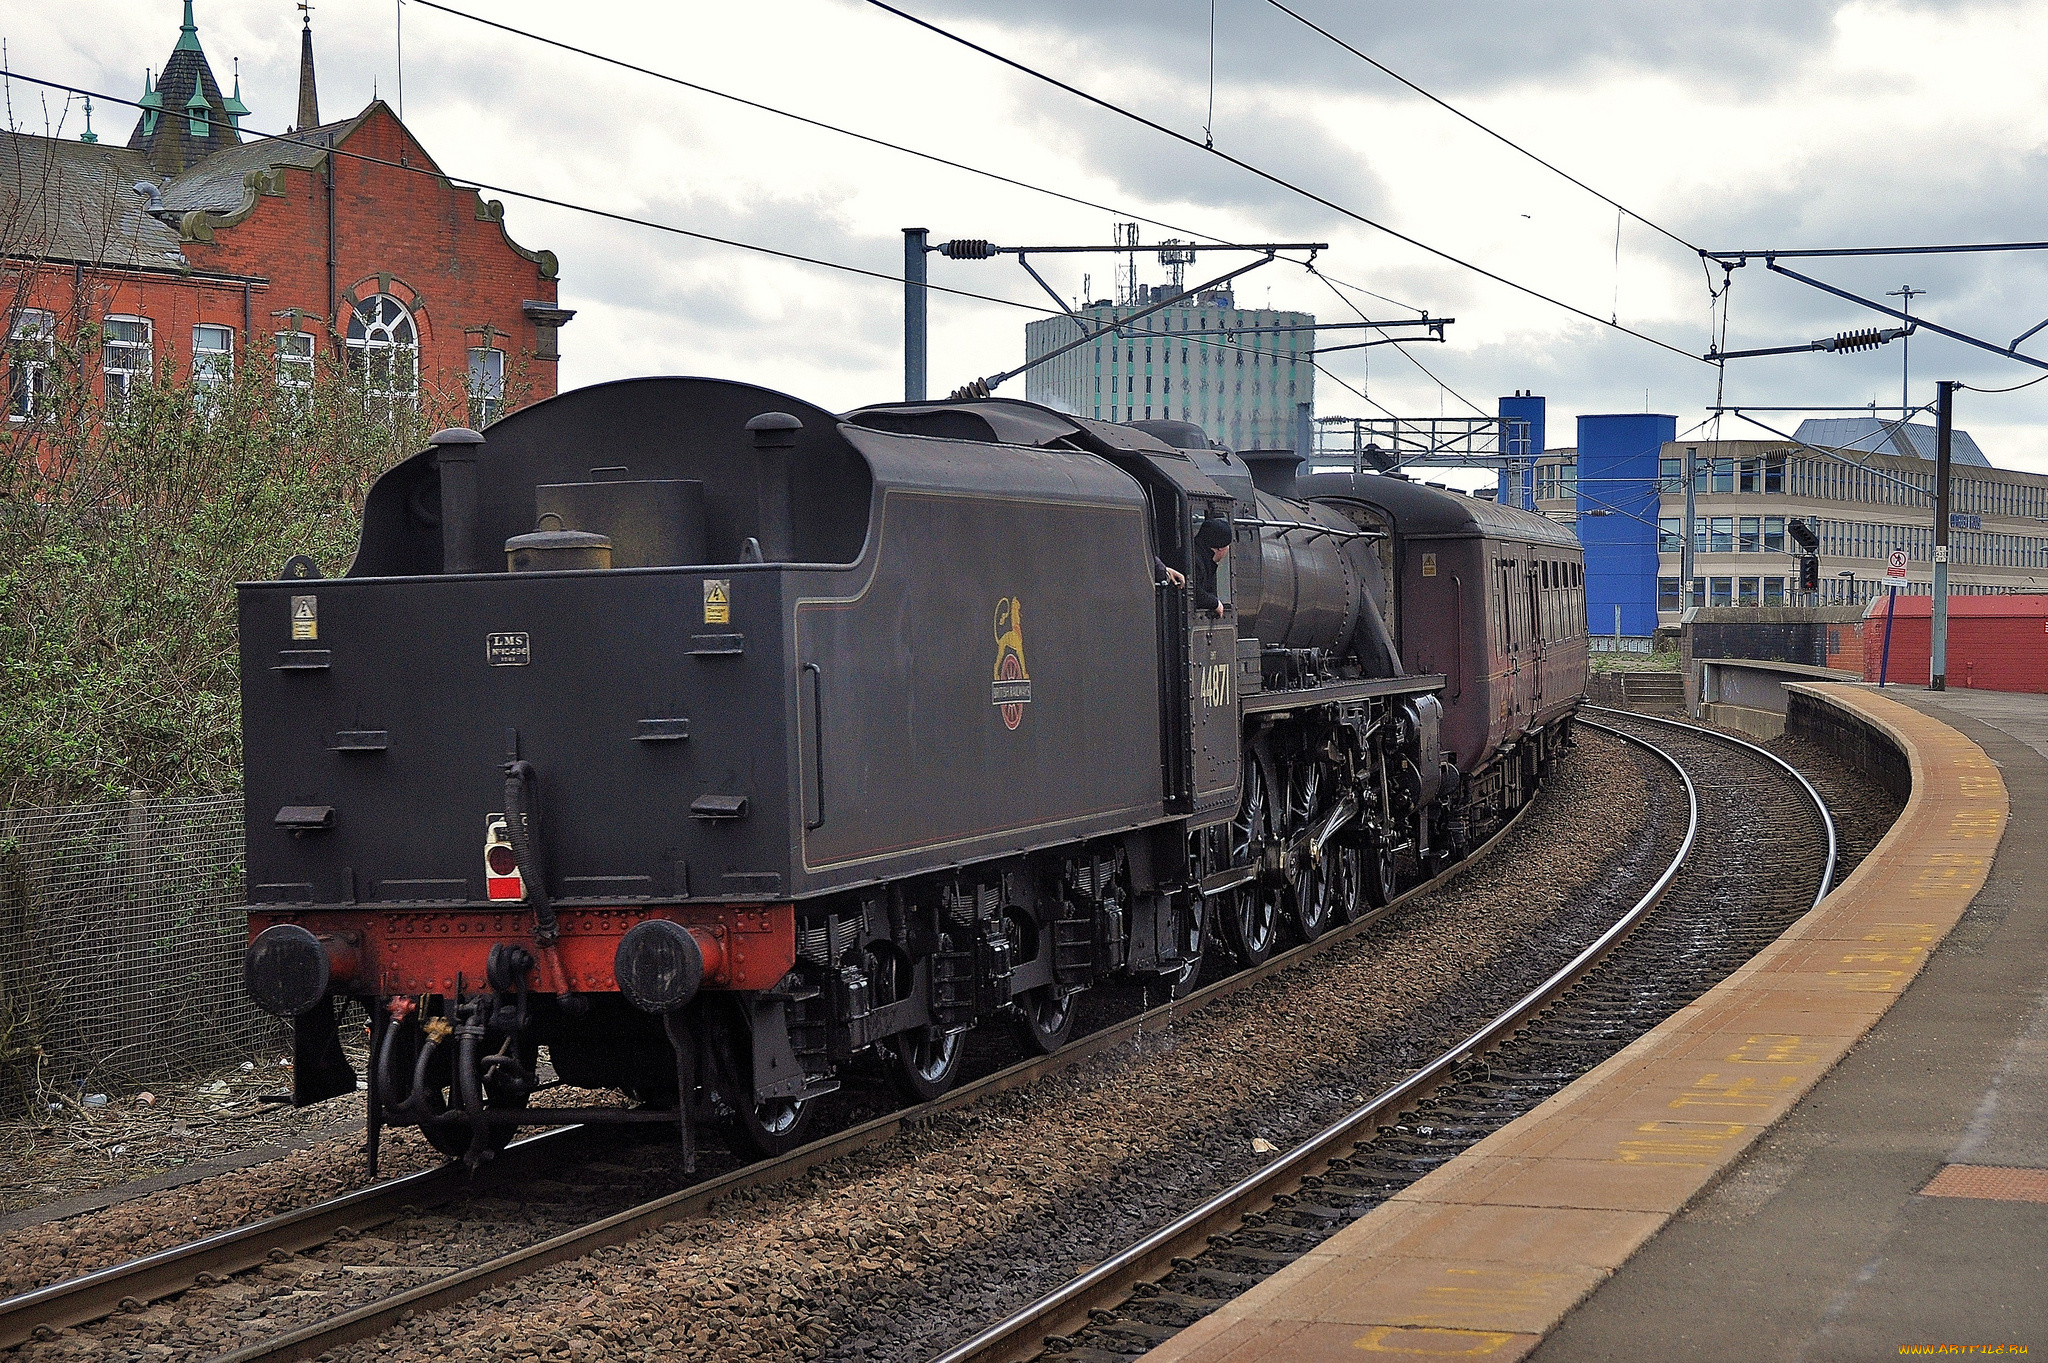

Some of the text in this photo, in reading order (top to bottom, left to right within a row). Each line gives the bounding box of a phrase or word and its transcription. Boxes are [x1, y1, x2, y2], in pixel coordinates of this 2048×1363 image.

[493, 636, 523, 646] LMS
[1200, 663, 1230, 708] 44871
[1668, 1073, 1799, 1108] THE
